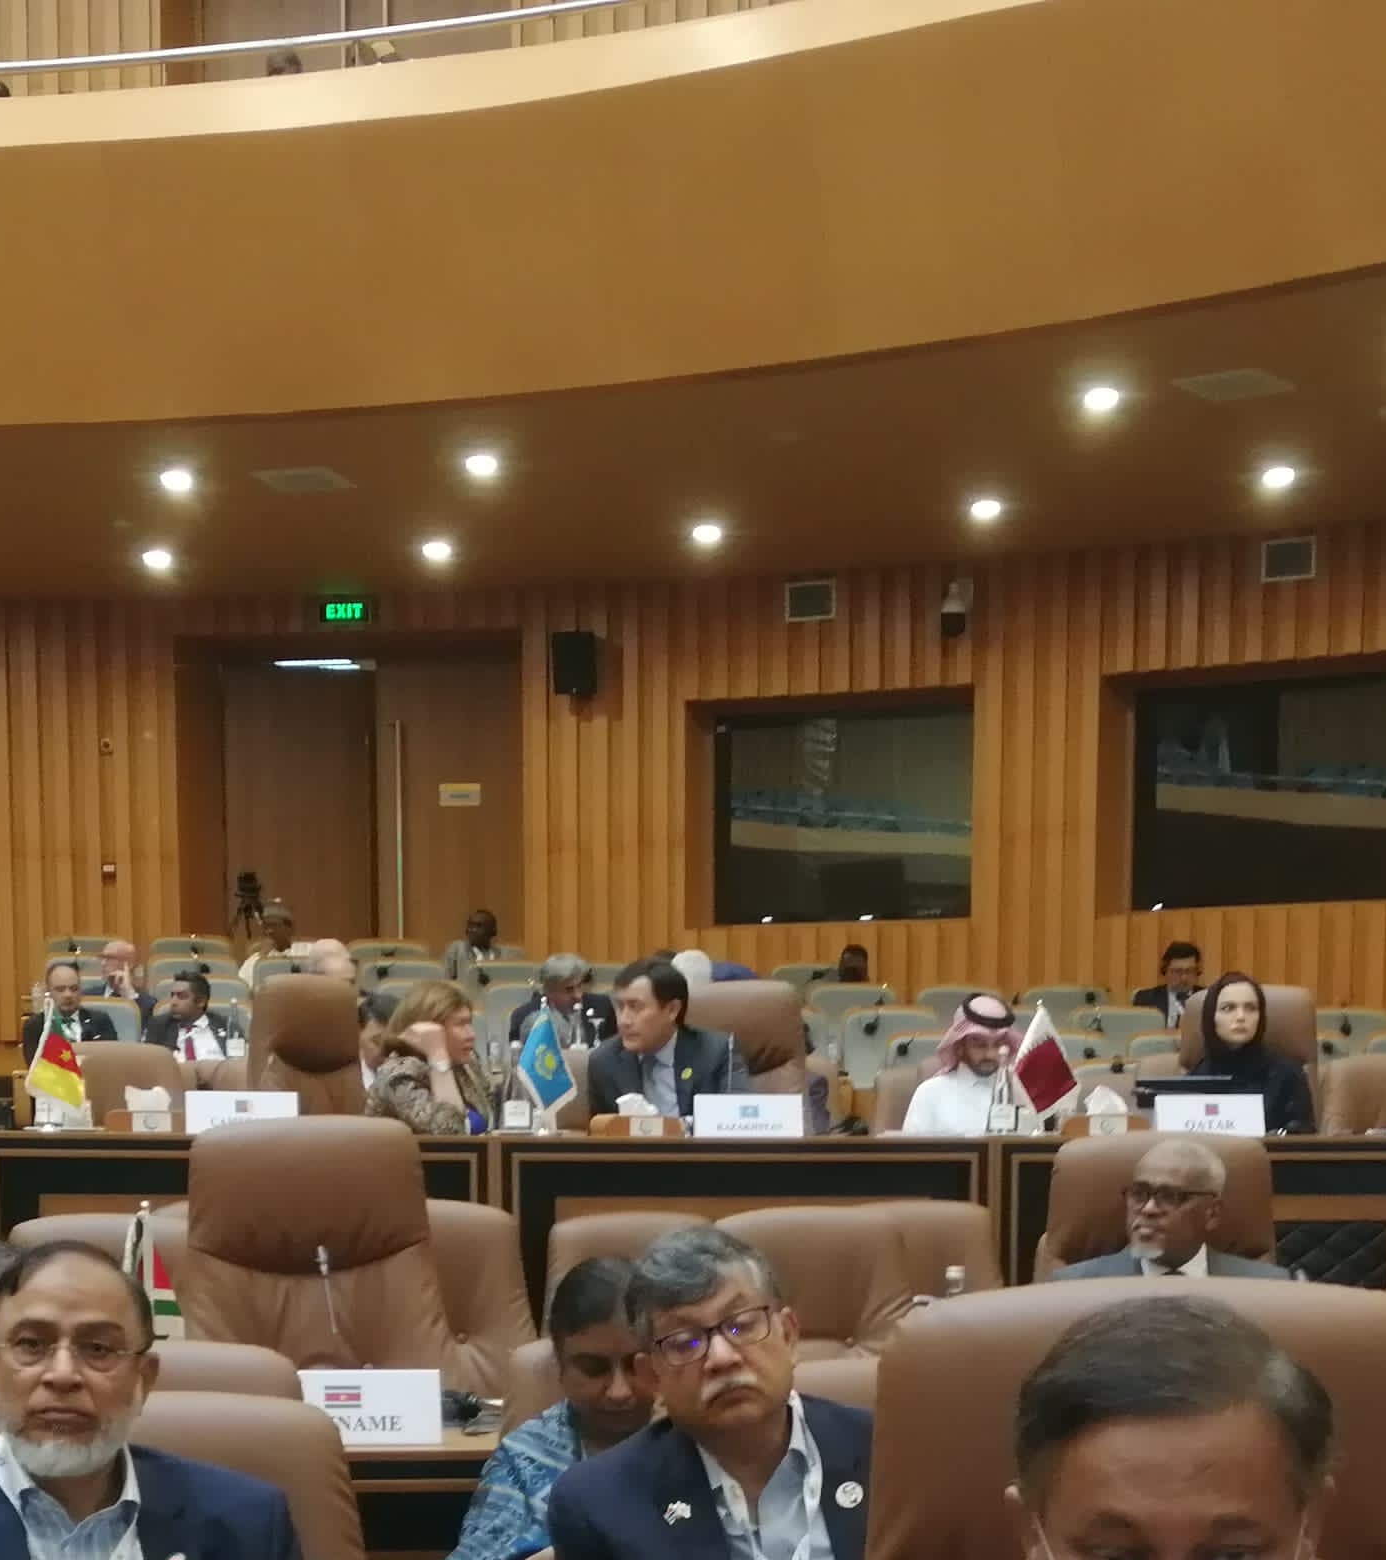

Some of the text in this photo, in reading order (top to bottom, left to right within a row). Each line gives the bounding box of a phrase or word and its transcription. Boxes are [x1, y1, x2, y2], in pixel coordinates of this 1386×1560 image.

[326, 603, 363, 620] EXIT
[1184, 1119, 1237, 1133] QATAR
[333, 1415, 403, 1432] NAME
